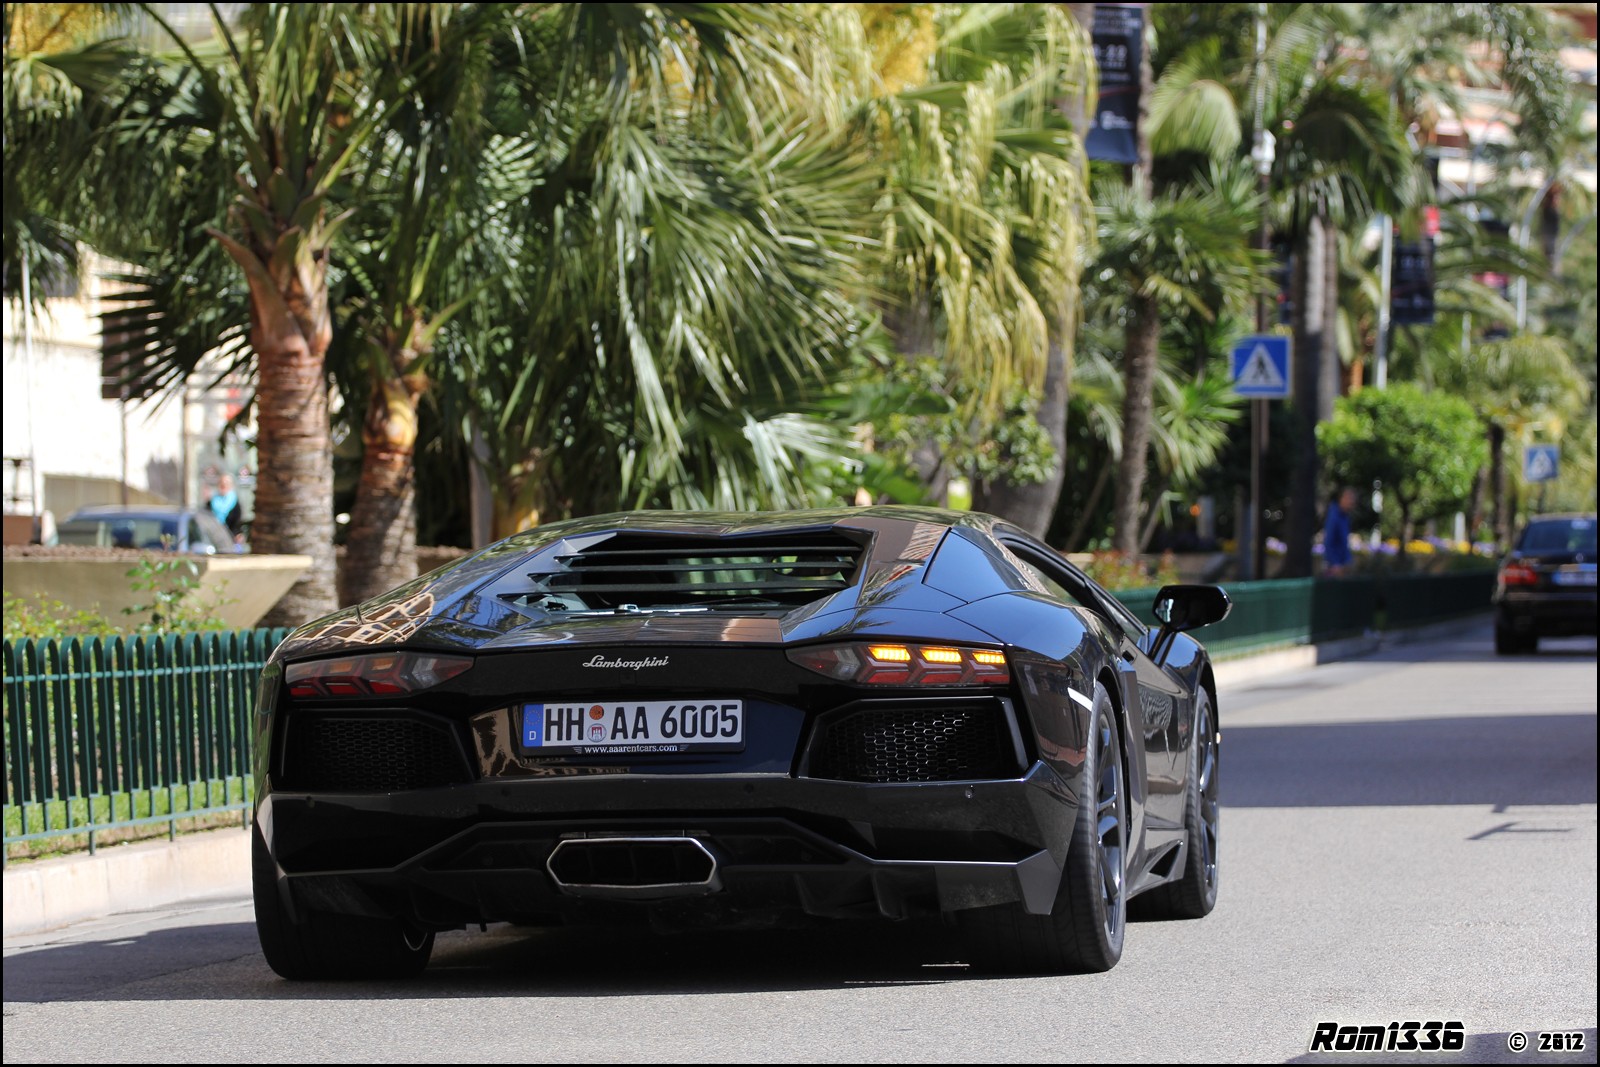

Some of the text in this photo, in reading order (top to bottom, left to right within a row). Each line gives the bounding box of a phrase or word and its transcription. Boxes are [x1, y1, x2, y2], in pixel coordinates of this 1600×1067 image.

[582, 655, 670, 671] Lamborghini
[545, 704, 739, 742] HH AA 6005
[529, 731, 537, 741] D
[584, 744, 678, 754] www.aaarentcars.com
